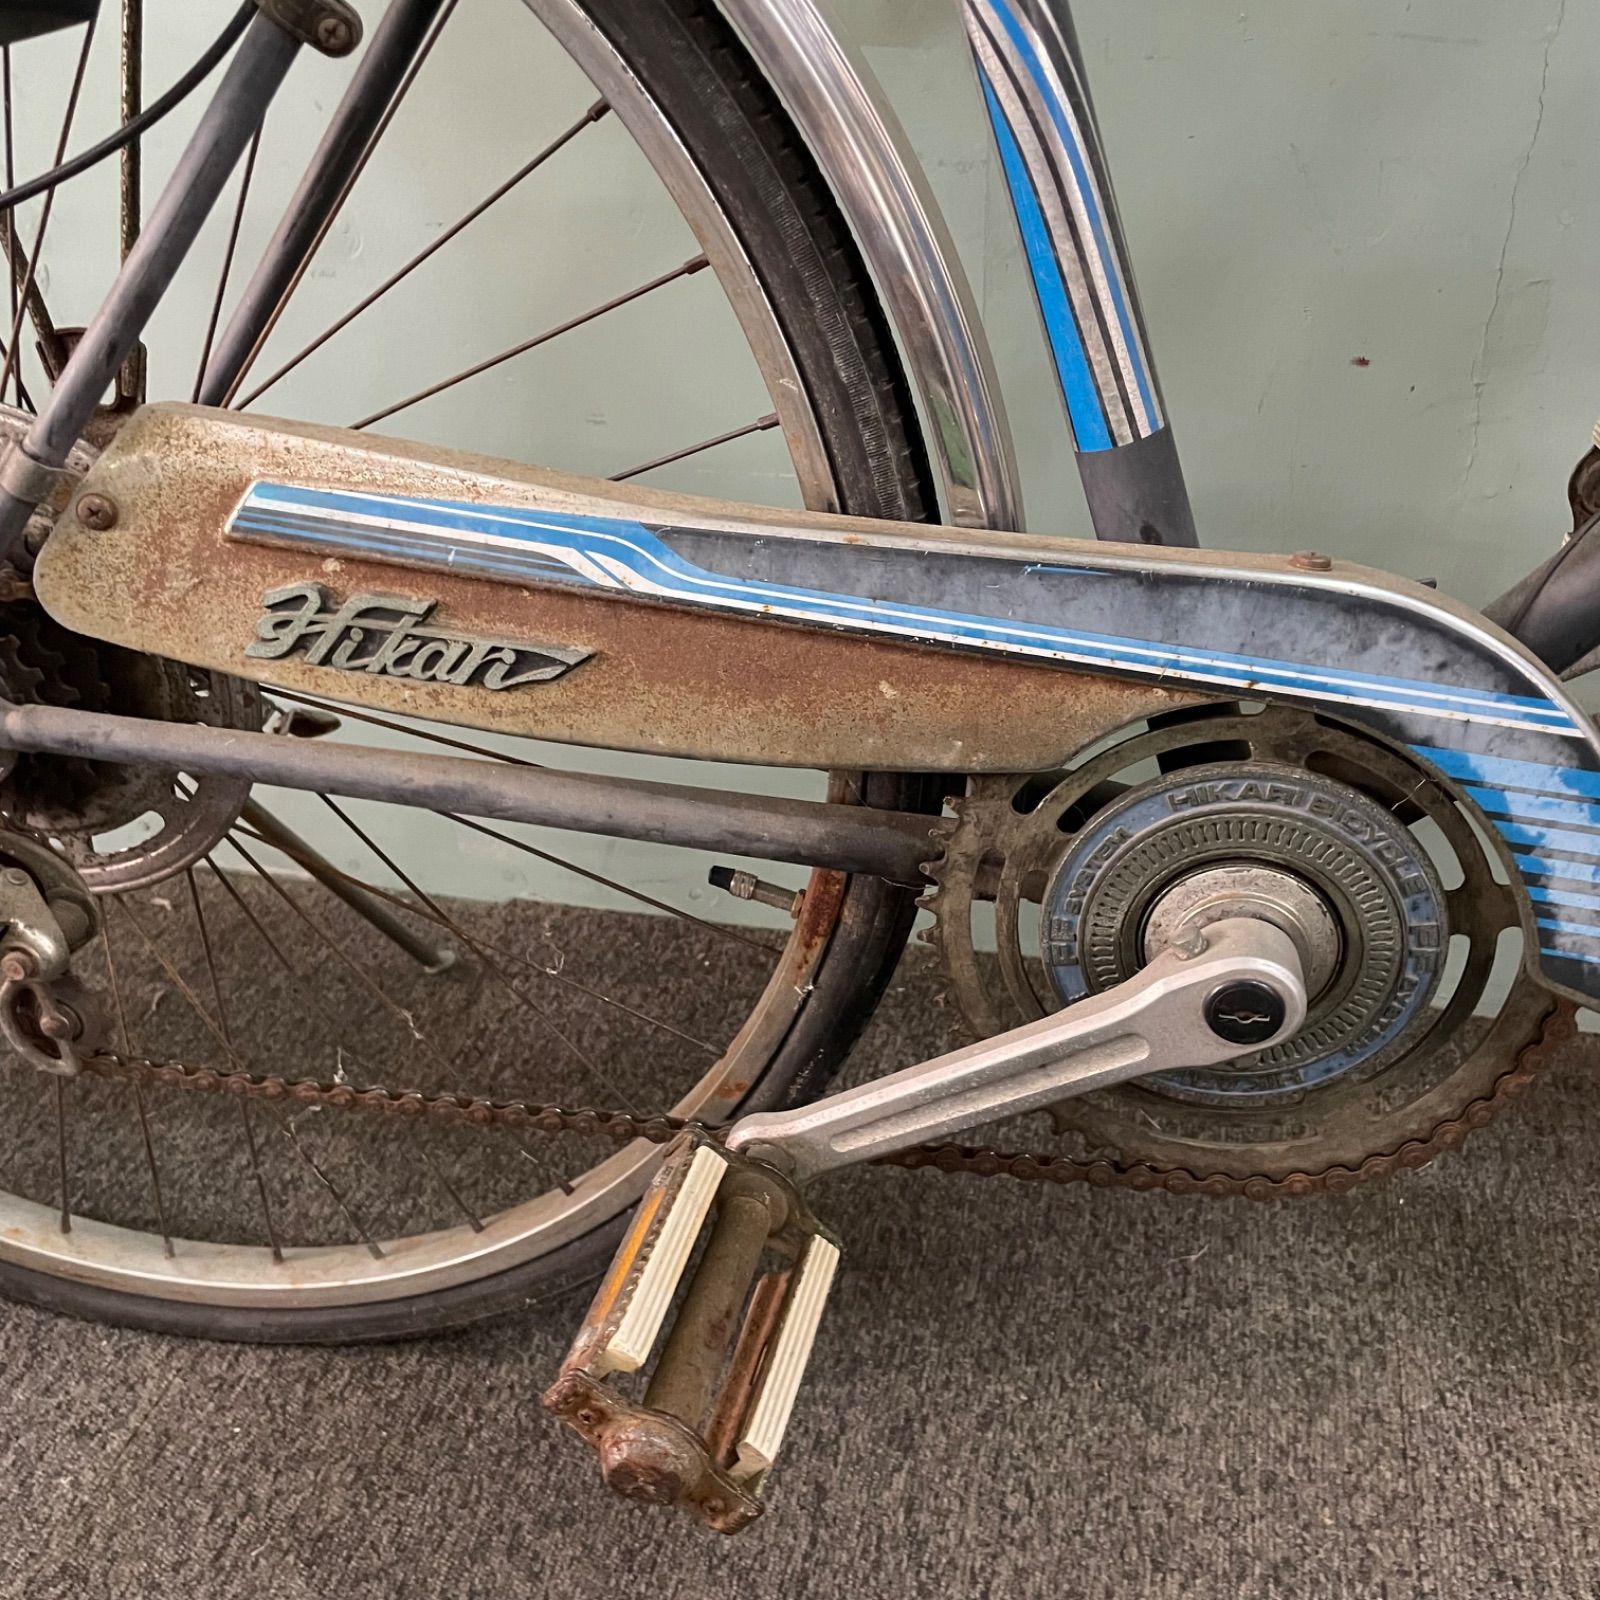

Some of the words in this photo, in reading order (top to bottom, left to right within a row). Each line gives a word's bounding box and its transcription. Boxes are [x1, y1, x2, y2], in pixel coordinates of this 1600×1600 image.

[245, 582, 596, 691] Hikari
[1064, 826, 1135, 916] SYSTEM
[1166, 783, 1302, 812] HIKARI
[1305, 791, 1428, 897] BICYCLE
